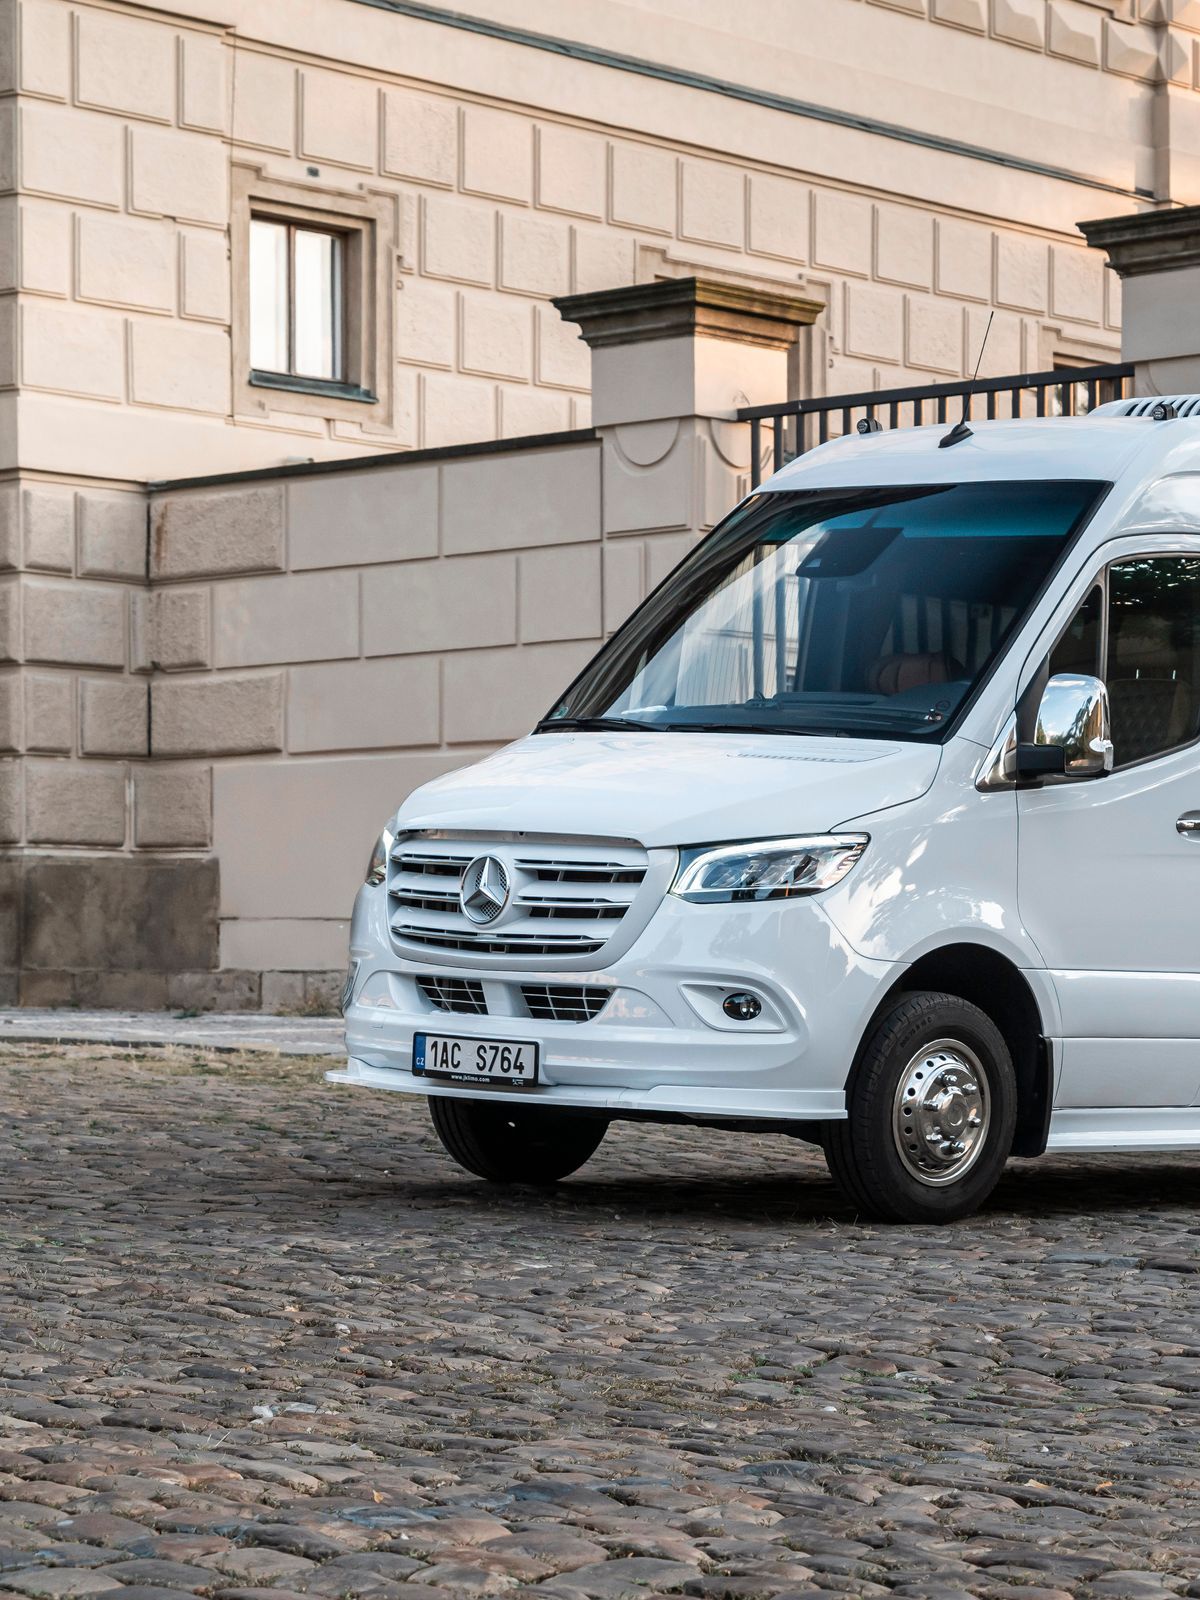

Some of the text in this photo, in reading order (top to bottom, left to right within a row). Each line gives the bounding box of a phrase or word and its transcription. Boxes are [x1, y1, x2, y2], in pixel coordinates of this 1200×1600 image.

[416, 1057, 424, 1066] CZ
[430, 1040, 525, 1075] 1AC S764
